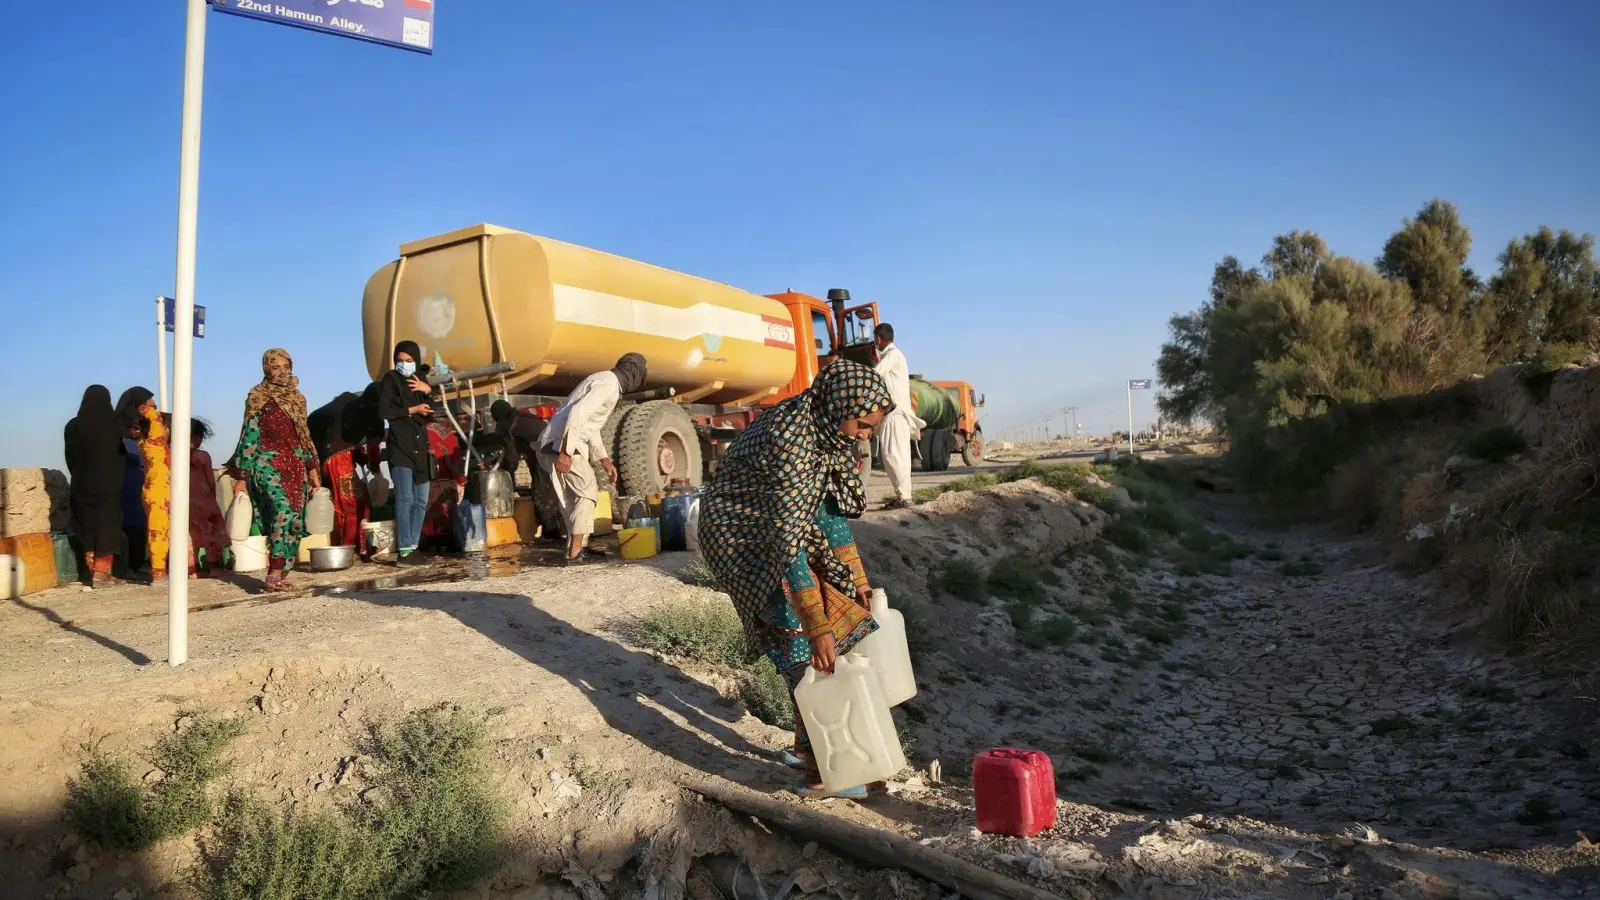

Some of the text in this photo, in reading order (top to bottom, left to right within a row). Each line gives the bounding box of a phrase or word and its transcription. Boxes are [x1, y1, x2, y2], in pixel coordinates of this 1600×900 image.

[236, 0, 366, 33] 22nd Hamun Alley.
